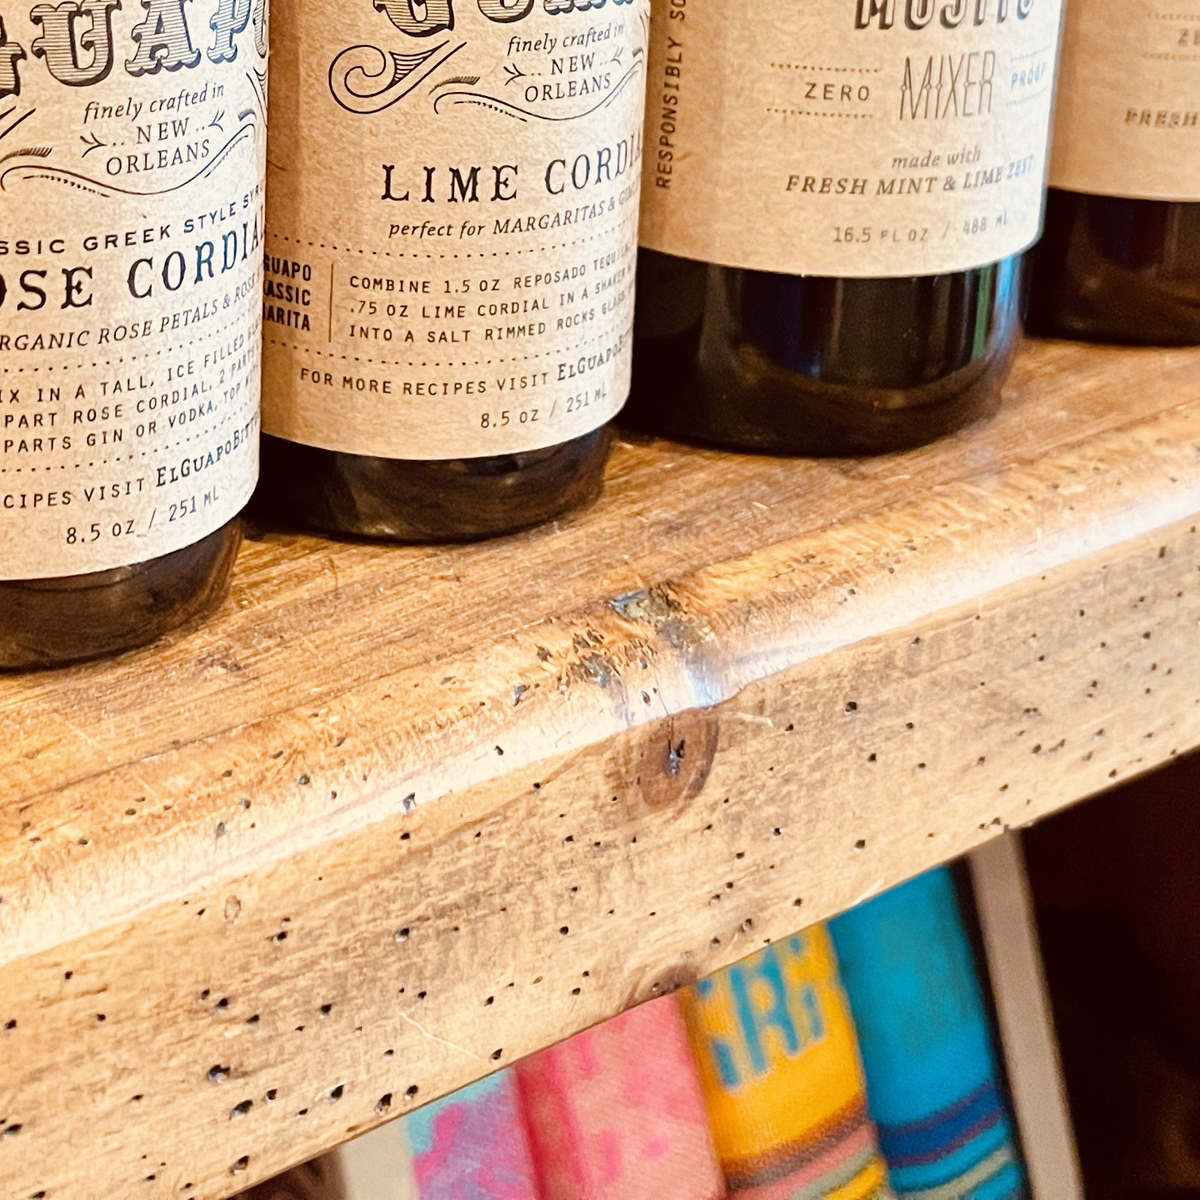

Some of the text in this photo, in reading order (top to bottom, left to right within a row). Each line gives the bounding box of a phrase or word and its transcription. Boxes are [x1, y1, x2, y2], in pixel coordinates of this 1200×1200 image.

[507, 23, 624, 57] finely crafted in
[550, 52, 596, 77] NEW
[83, 81, 225, 125] finely crafted in
[524, 72, 612, 104] ORLEANS
[804, 82, 870, 102] ZERO
[900, 50, 995, 120] MIXER
[135, 117, 190, 146] NEW
[656, 37, 683, 190] RESPONSIBLY
[106, 137, 211, 177] ORLEANS
[785, 153, 1035, 196] FRESH MINT & LIME ZEST
[891, 145, 981, 170] made with
[381, 163, 519, 204] LIME
[83, 224, 172, 252] GREEK
[183, 202, 237, 234] STYLE
[388, 196, 616, 240] perfect for MARGARITAS &
[832, 219, 988, 244] 16.5 FL OZ 488
[263, 254, 312, 282] GUAPO
[349, 264, 586, 294] COMBINE 1.5 OZ REPOSADO
[97, 320, 153, 345] ROSE
[159, 298, 218, 333] PETALS
[222, 292, 231, 310] &
[349, 286, 589, 320] .75 OZ LIME CORDIAL IN A
[349, 308, 595, 344] INTO A SALT RIMMED ROCKS
[37, 387, 61, 403] IN
[75, 385, 86, 400] A
[100, 375, 155, 397] TALL,
[167, 360, 195, 382] ICE
[203, 333, 244, 368] FILLED
[300, 367, 549, 396] FOR MORE RECIPES VISIT
[4, 411, 59, 430] PART
[73, 403, 124, 425] ROSE
[218, 368, 226, 385] 2
[480, 410, 511, 430] 8.5
[566, 390, 590, 414] 251
[3, 434, 72, 455] PARTS
[86, 429, 124, 449] GIN
[135, 421, 157, 439] OR
[223, 385, 241, 405] TOP
[83, 477, 145, 503] VISIT
[65, 524, 101, 546] 8.5
[168, 495, 197, 523] 251
[203, 485, 220, 508] ML
